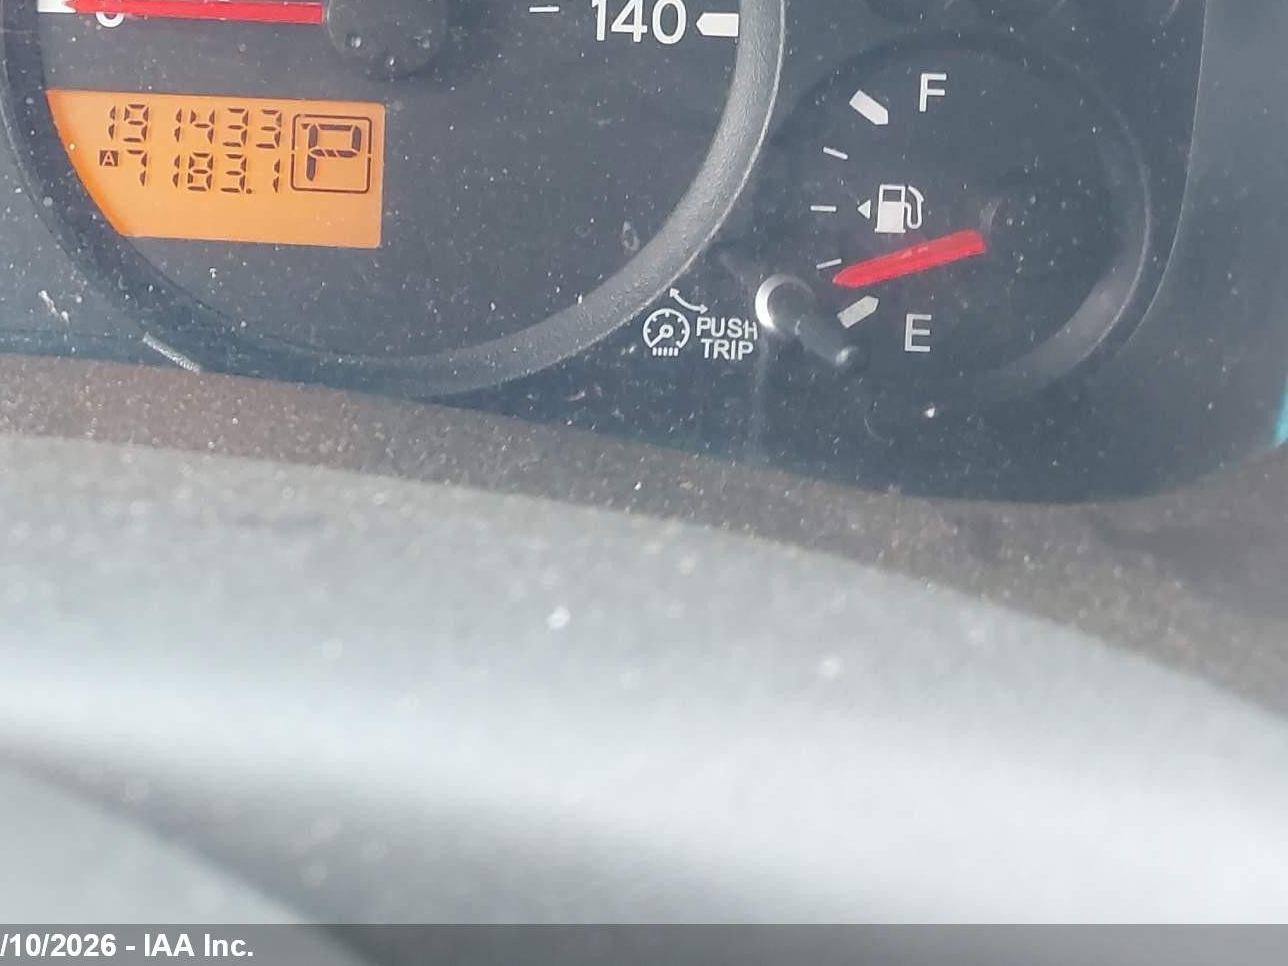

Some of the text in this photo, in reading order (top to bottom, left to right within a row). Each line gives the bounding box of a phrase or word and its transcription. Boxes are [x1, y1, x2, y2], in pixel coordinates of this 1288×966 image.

[919, 73, 947, 112] F
[108, 104, 282, 149] 191433
[126, 149, 280, 194] 7183.1
[302, 124, 362, 182] P
[696, 317, 758, 341] PUSH
[905, 313, 932, 352] E
[701, 339, 754, 361] TRIP
